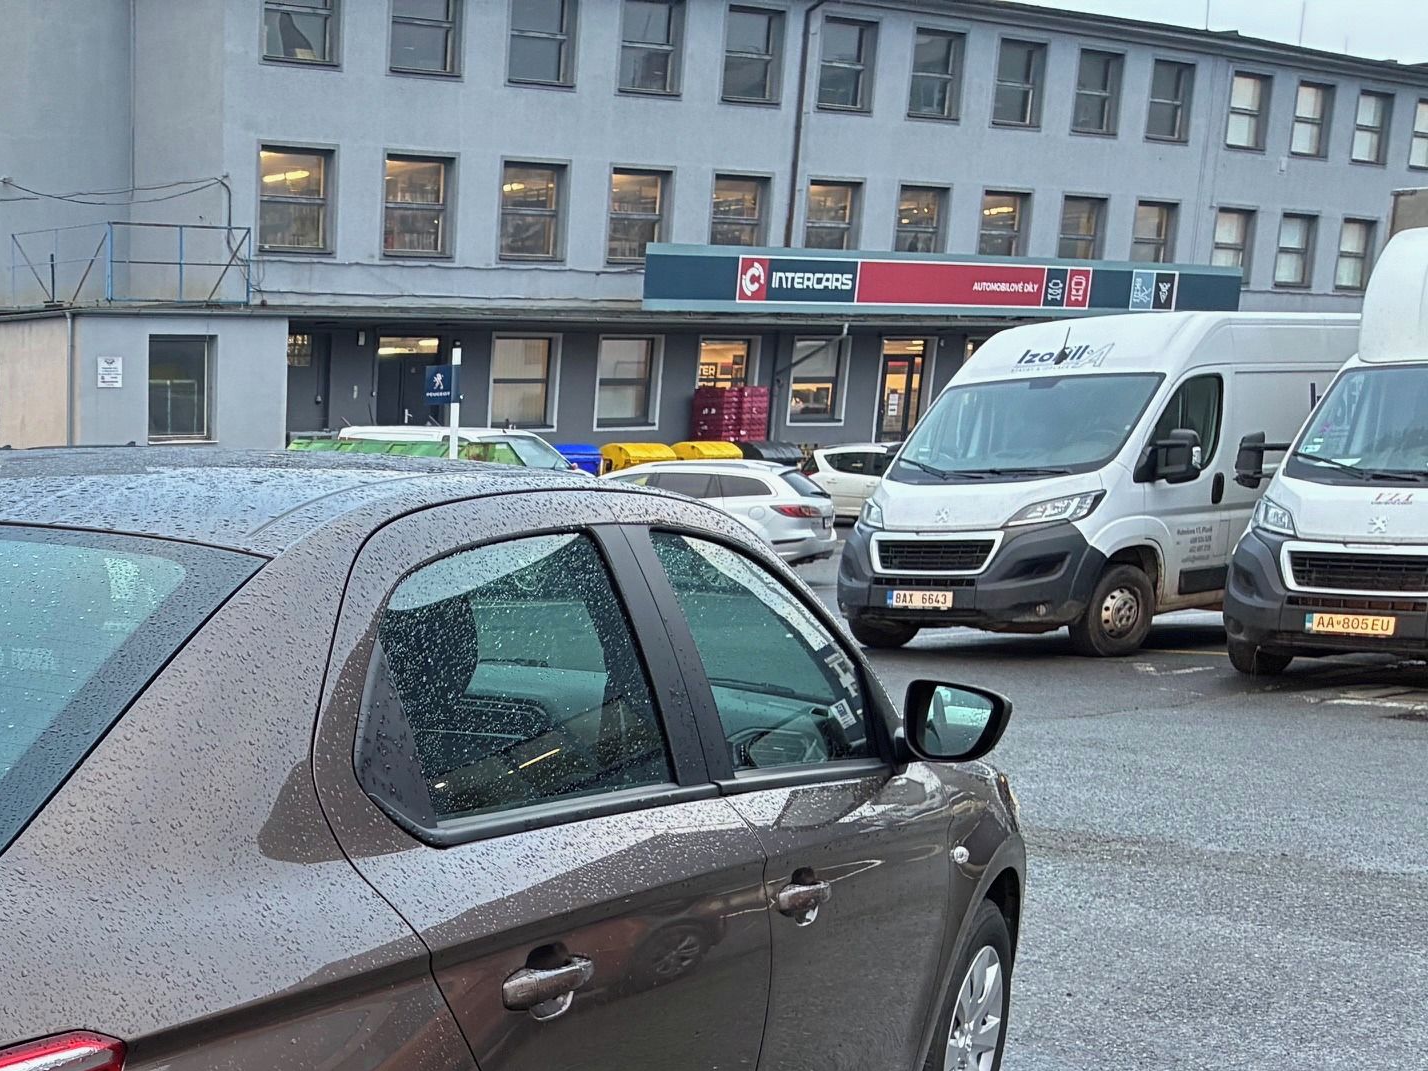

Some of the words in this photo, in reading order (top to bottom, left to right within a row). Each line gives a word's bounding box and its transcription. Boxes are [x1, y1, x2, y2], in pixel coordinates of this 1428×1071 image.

[972, 281, 1024, 292] AUTOMOBILOVÉ
[1024, 282, 1039, 293] DÍLY
[1017, 345, 1090, 364] Izoill
[895, 592, 914, 605] 8AX
[921, 593, 947, 605] 6643
[1316, 616, 1335, 629] AA
